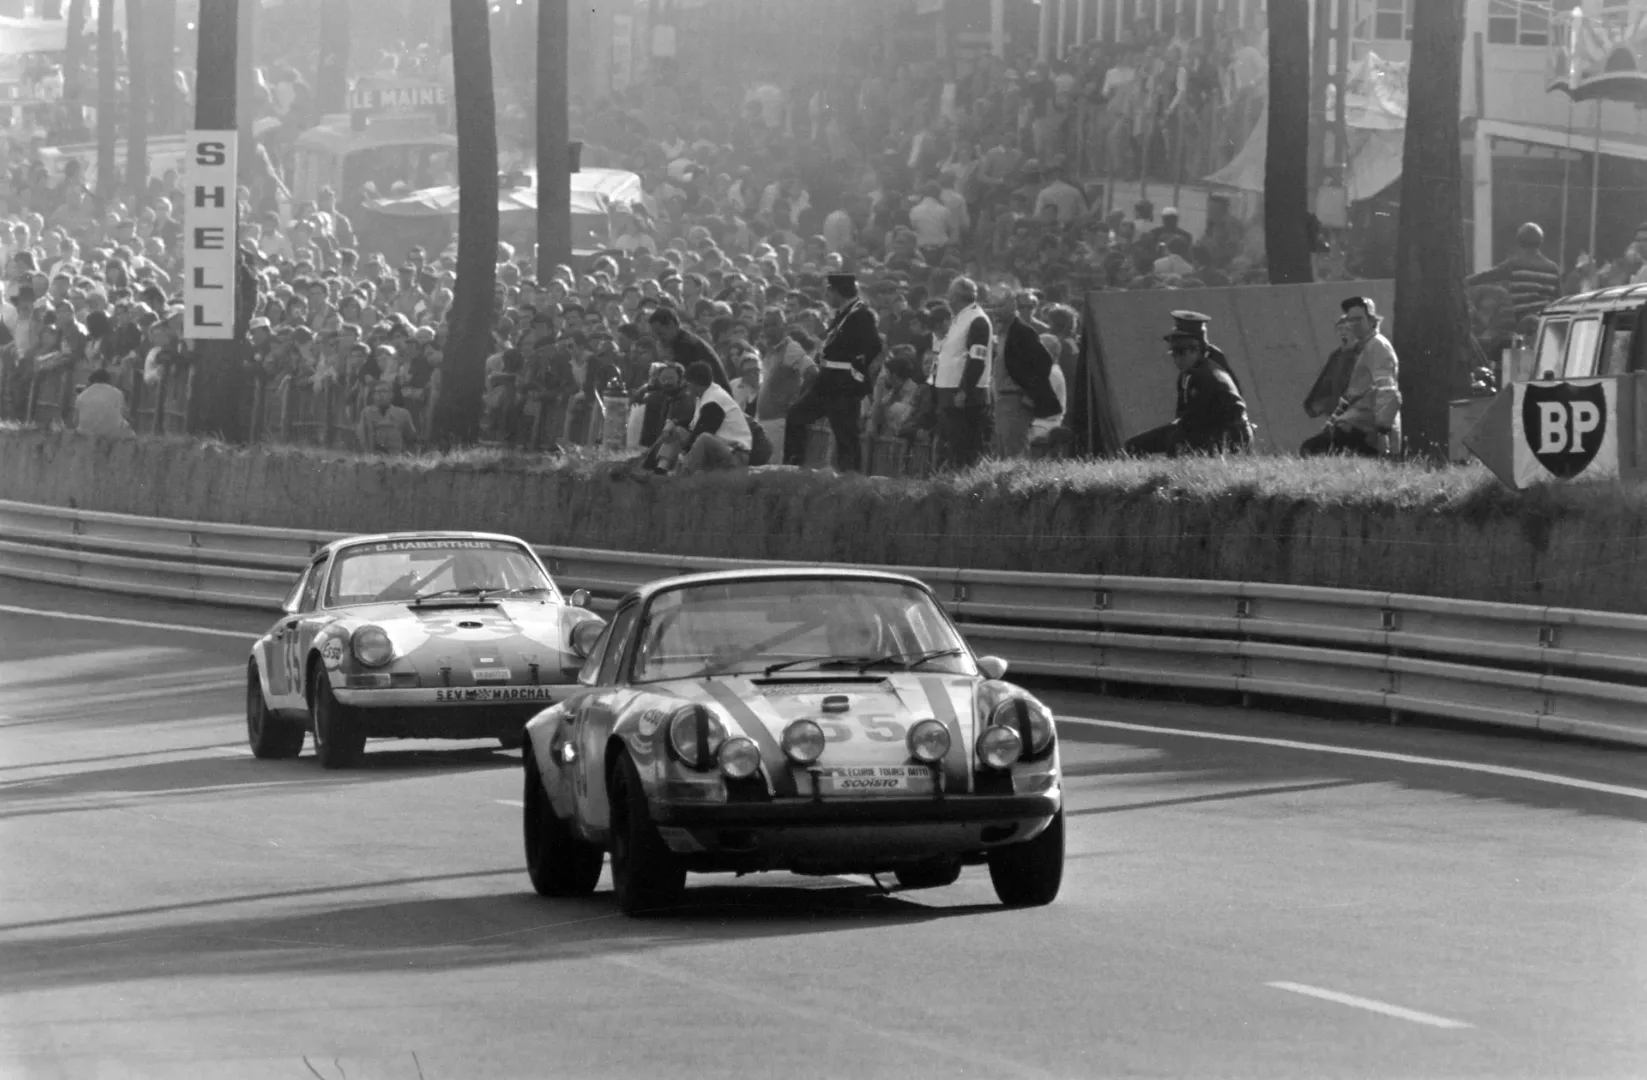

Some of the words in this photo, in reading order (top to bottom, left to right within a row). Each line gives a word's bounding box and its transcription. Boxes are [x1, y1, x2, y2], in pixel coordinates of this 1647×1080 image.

[352, 90, 374, 109] LE
[380, 87, 449, 107] MAINE
[194, 142, 225, 327] SHELL
[1536, 401, 1600, 454] BP
[492, 688, 552, 701] MARCHAL
